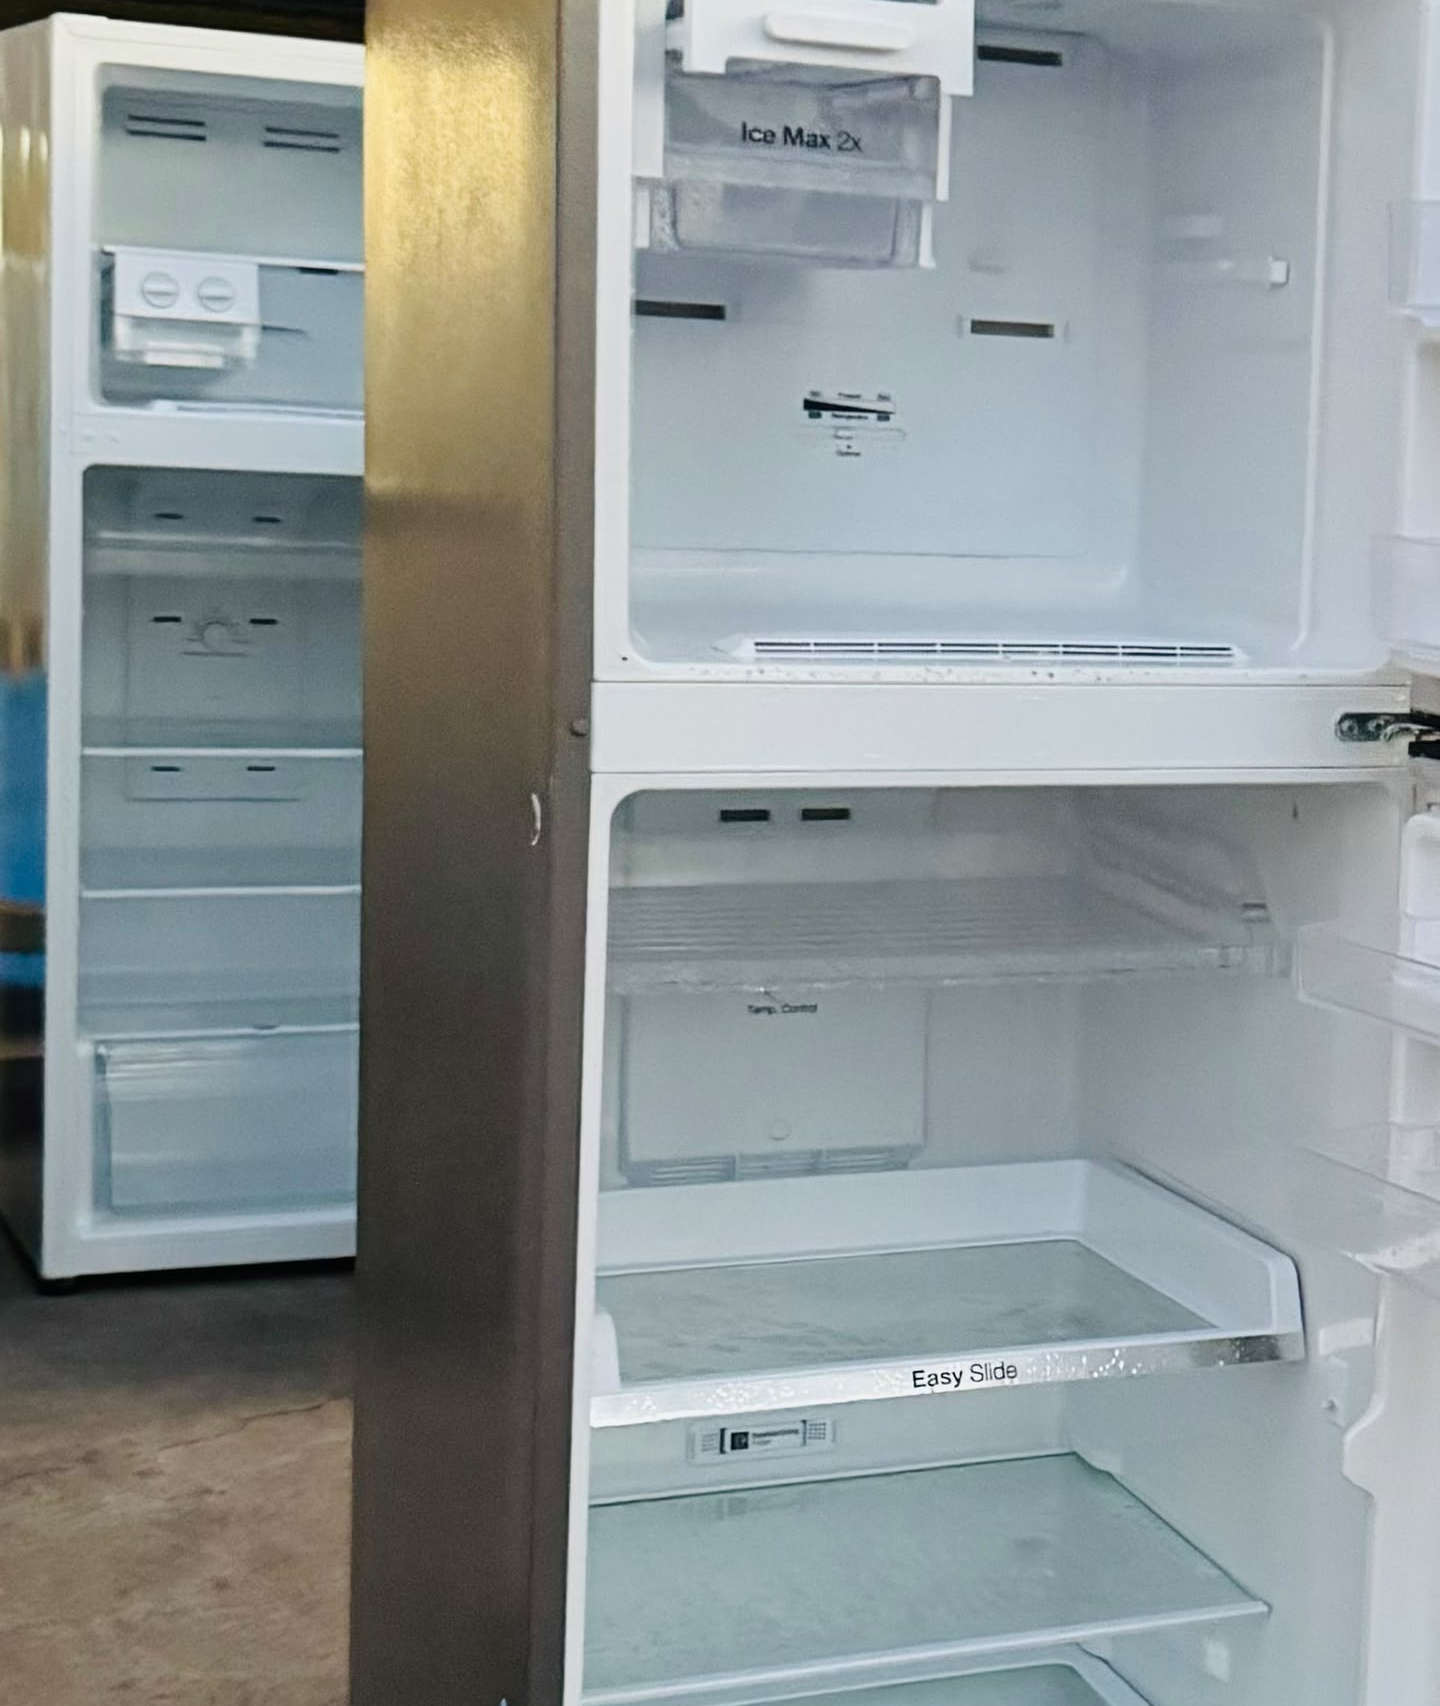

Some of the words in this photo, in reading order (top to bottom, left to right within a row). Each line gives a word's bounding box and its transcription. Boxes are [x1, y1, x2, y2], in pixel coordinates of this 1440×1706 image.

[741, 121, 776, 145] Ice
[783, 125, 830, 150] Max
[837, 129, 863, 153] 2x
[912, 1369, 963, 1389] Easy
[969, 1361, 1018, 1382] Slide
